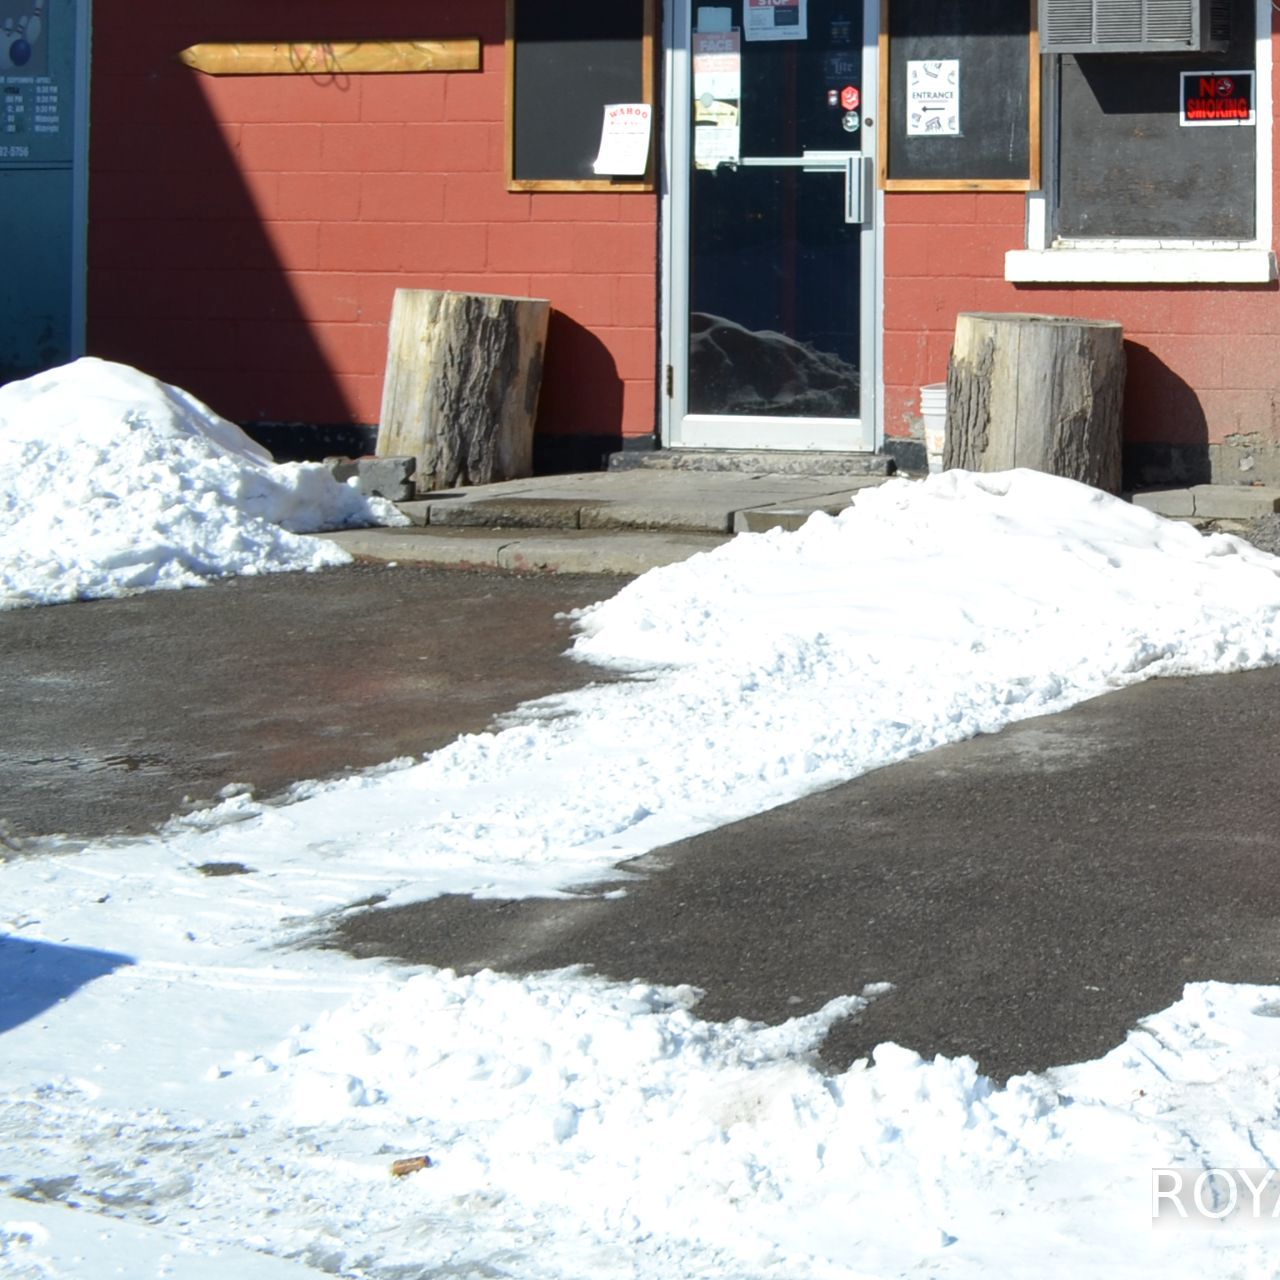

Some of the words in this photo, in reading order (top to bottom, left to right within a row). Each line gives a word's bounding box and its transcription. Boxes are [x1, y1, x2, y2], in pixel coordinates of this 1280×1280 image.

[912, 90, 953, 99] ENTRANCE
[609, 107, 648, 119] WAHOO
[1187, 97, 1249, 118] SMOKING
